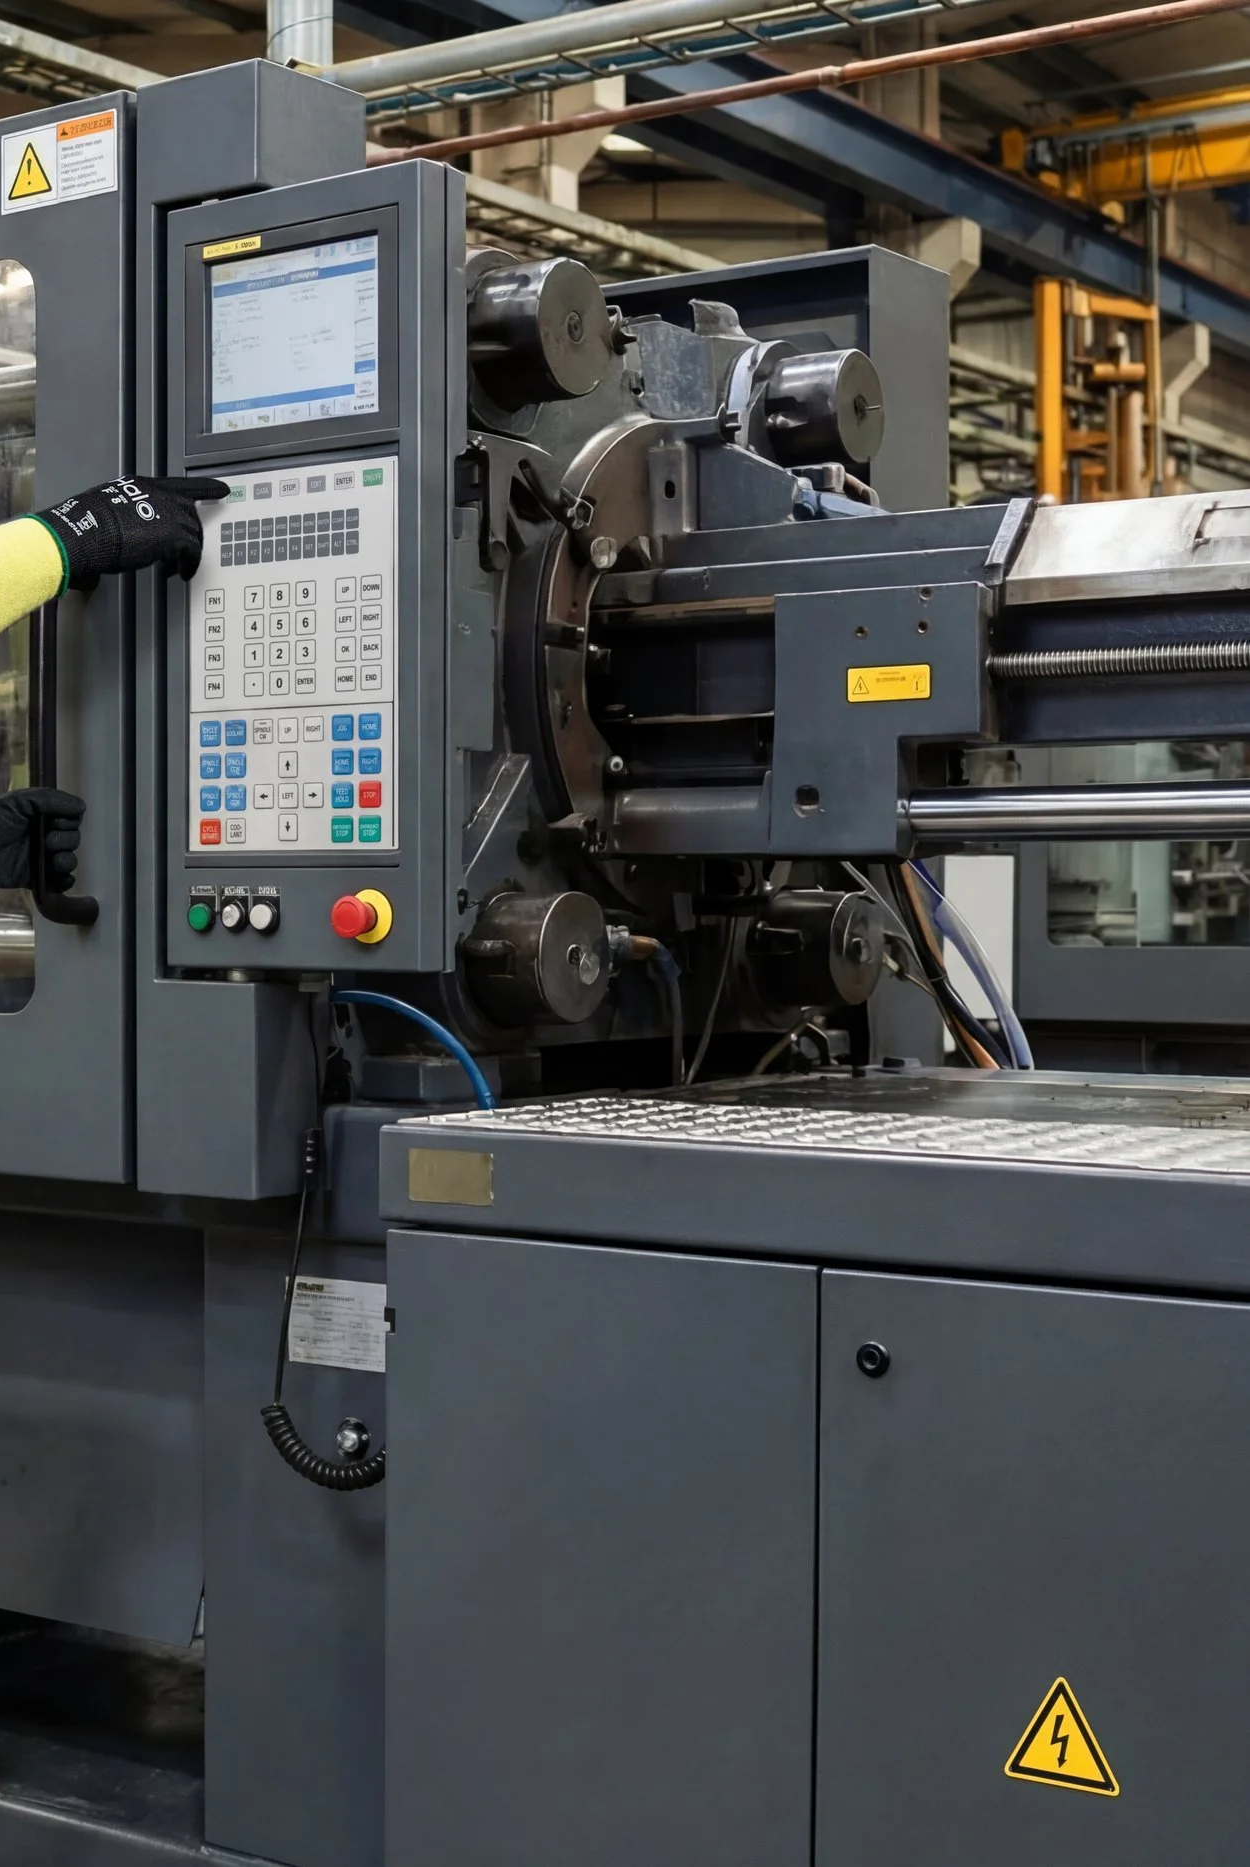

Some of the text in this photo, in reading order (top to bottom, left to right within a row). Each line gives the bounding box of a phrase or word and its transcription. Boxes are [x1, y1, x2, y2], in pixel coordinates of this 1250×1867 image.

[109, 476, 156, 521] Halo
[251, 592, 258, 603] 7
[276, 590, 283, 601] 8
[302, 588, 309, 598] 9
[251, 621, 258, 632] 4
[276, 619, 283, 630] 5
[302, 617, 309, 628] 6
[208, 626, 221, 634] FN2
[251, 650, 256, 660] 1
[276, 649, 283, 659] 2
[302, 647, 309, 657] 3
[208, 654, 221, 662] FN3
[208, 683, 221, 691] FN4
[276, 678, 283, 688] 0
